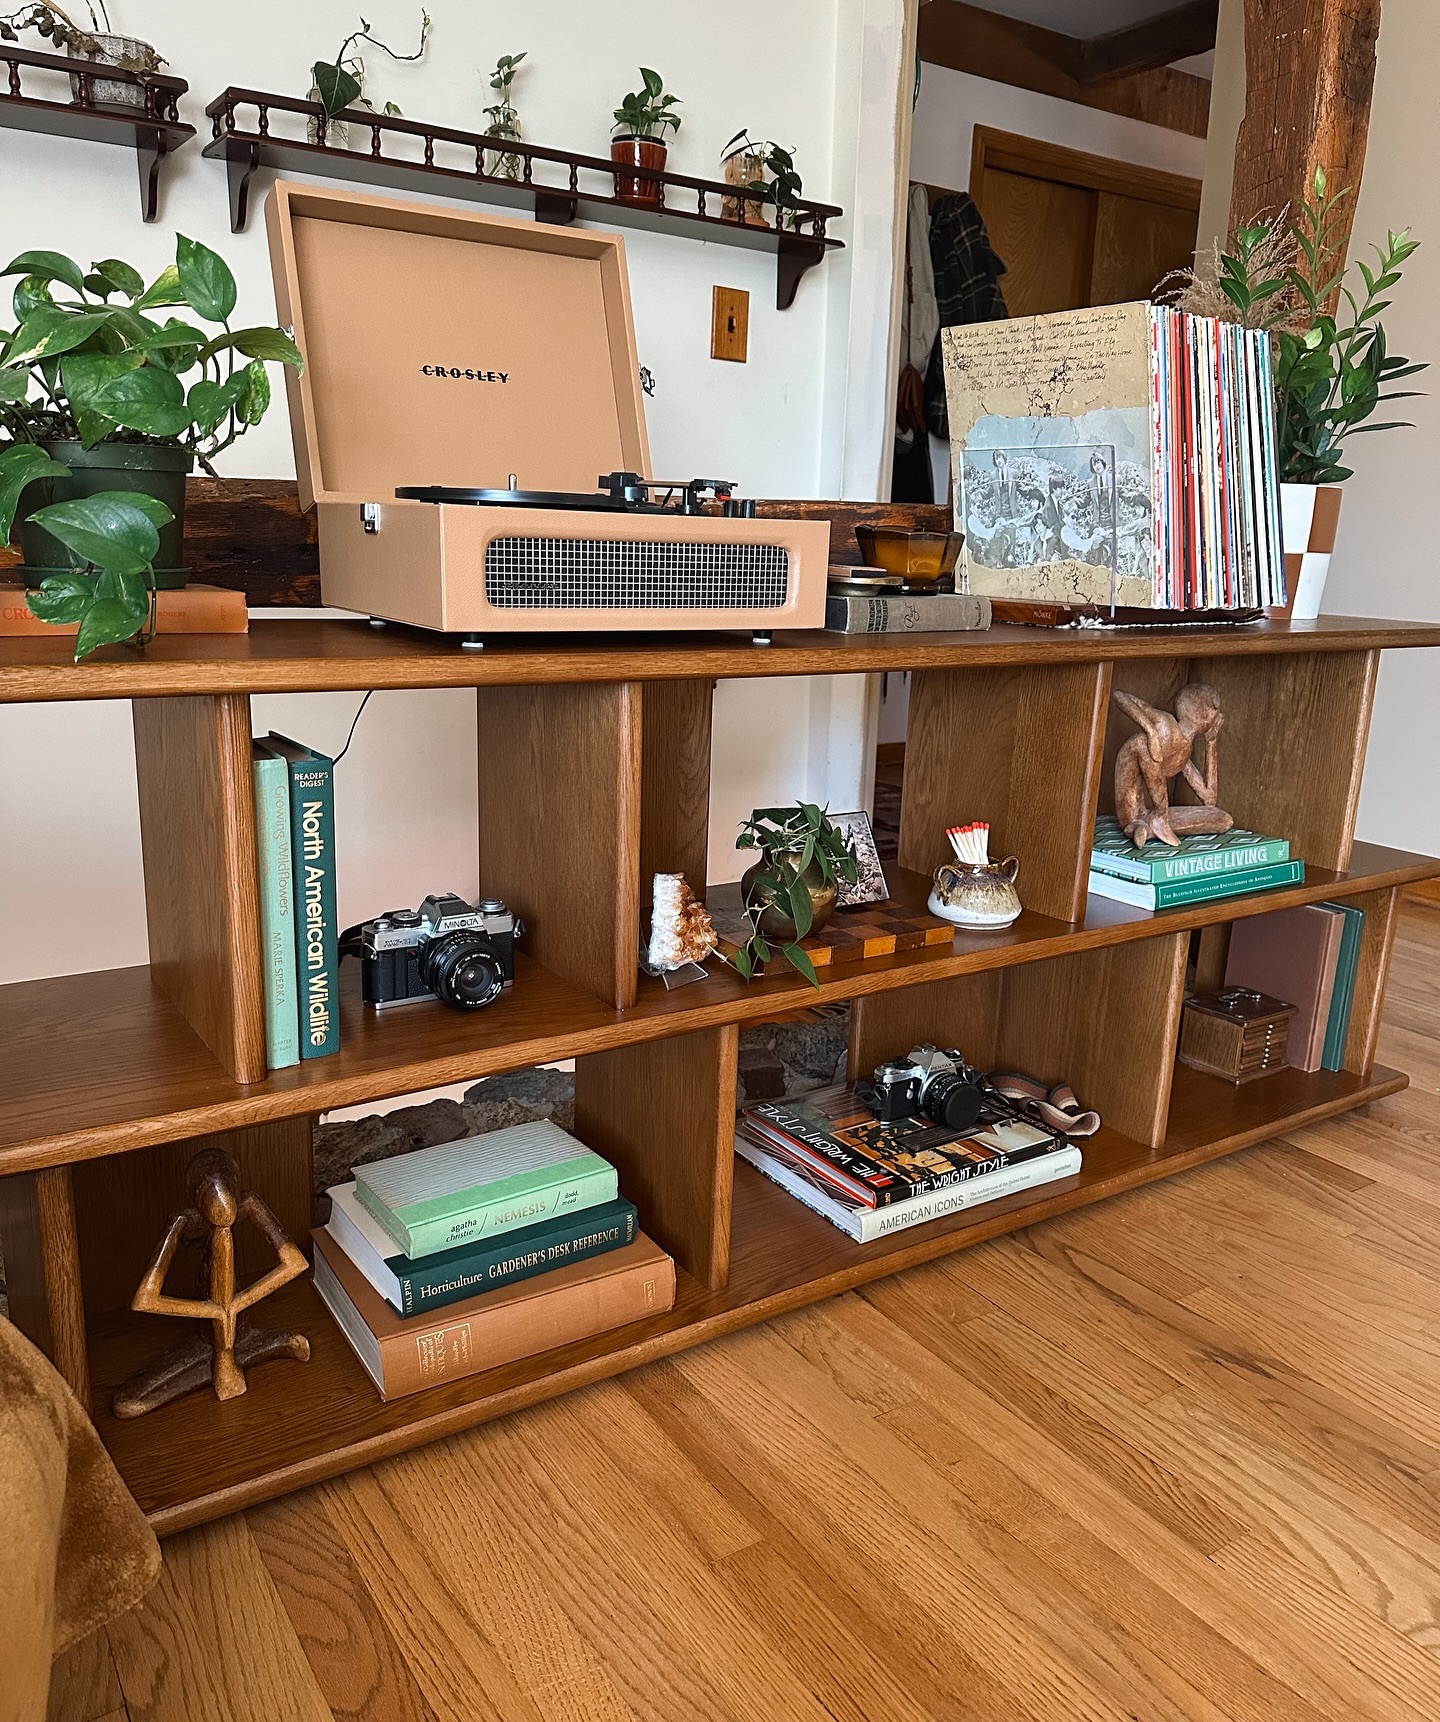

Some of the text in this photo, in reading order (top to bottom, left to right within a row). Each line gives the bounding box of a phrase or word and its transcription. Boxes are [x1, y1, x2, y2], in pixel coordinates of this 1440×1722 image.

[421, 365, 509, 383] CROSLEY
[2, 607, 34, 620] CRO
[294, 772, 328, 780] READER'S
[300, 780, 324, 788] DIGEST
[273, 785, 289, 916] Growing Wildflowers
[1165, 855, 1222, 878] VINTAGE
[1225, 847, 1268, 868] LIVING
[302, 801, 329, 1046] North American Wildlife
[444, 917, 479, 929] MINOLTA
[272, 931, 284, 1006] MARIE SPERKA
[930, 1063, 952, 1071] PENTAX
[758, 1103, 806, 1132] STYLE
[799, 1131, 853, 1165] WRIGHT
[852, 1162, 894, 1186] THE
[909, 1156, 1009, 1197] THE WRIGHT STYLE
[494, 1201, 546, 1225] NEMESIS
[562, 1197, 577, 1206] mead
[879, 1195, 964, 1231] AMERICAN ICONS
[446, 1229, 474, 1242] christie
[450, 1219, 477, 1233] agatha
[420, 1227, 619, 1299] Horticulture GARDENER'S DESK REFERENCE
[403, 1279, 412, 1314] HALPIN
